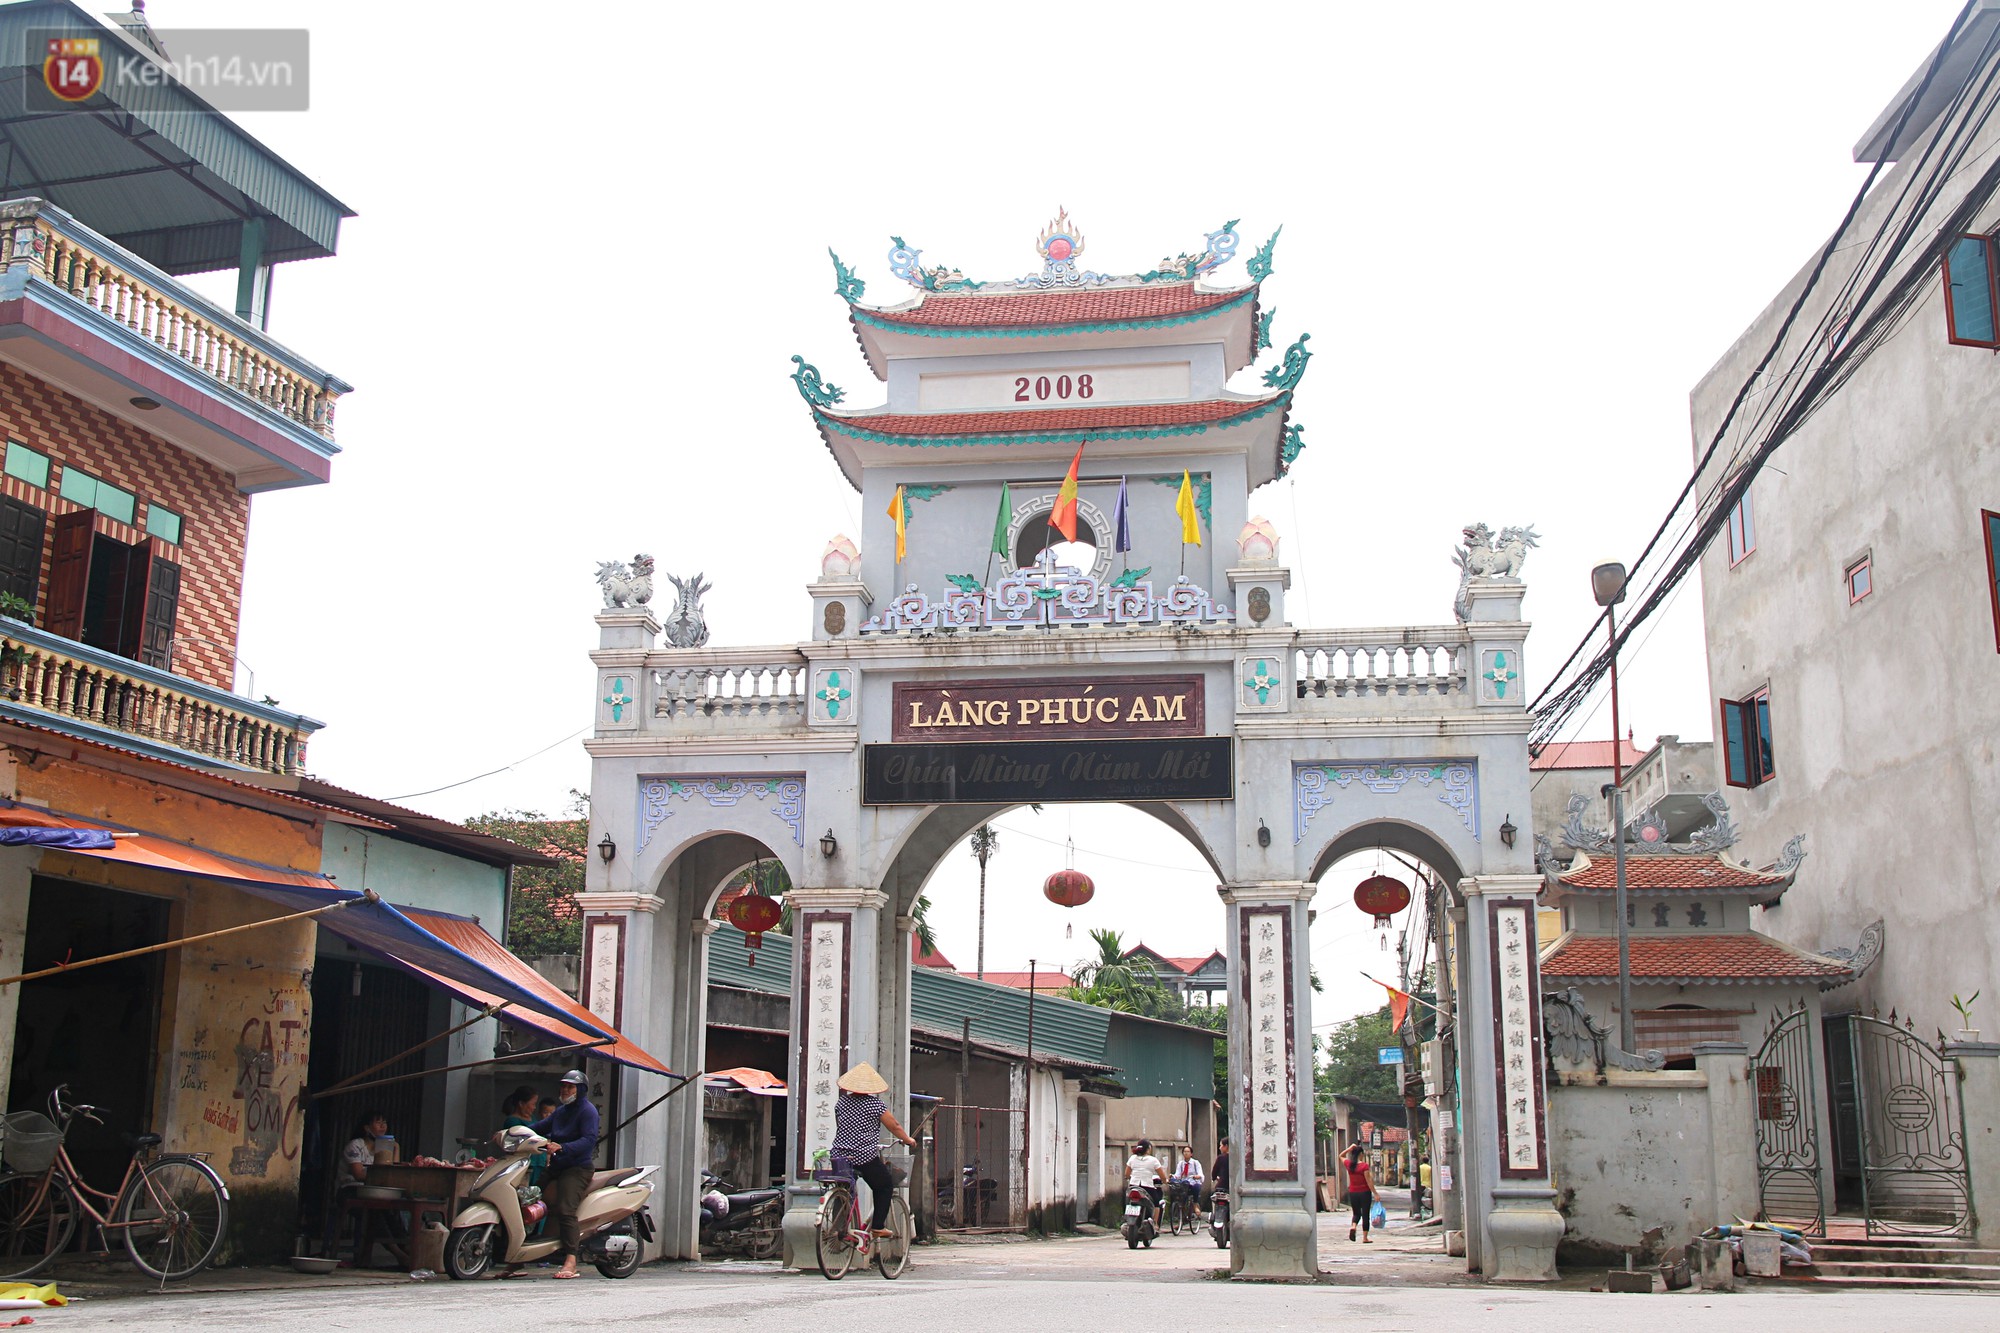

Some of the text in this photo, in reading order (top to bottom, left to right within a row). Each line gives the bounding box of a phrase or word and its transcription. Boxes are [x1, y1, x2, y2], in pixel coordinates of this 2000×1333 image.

[1014, 374, 1095, 402] 2008
[909, 685, 1187, 728] LÀNG PHÚC AM
[882, 749, 1212, 789] Chúc Mừng Năm Mới
[247, 1089, 281, 1134] ÔM
